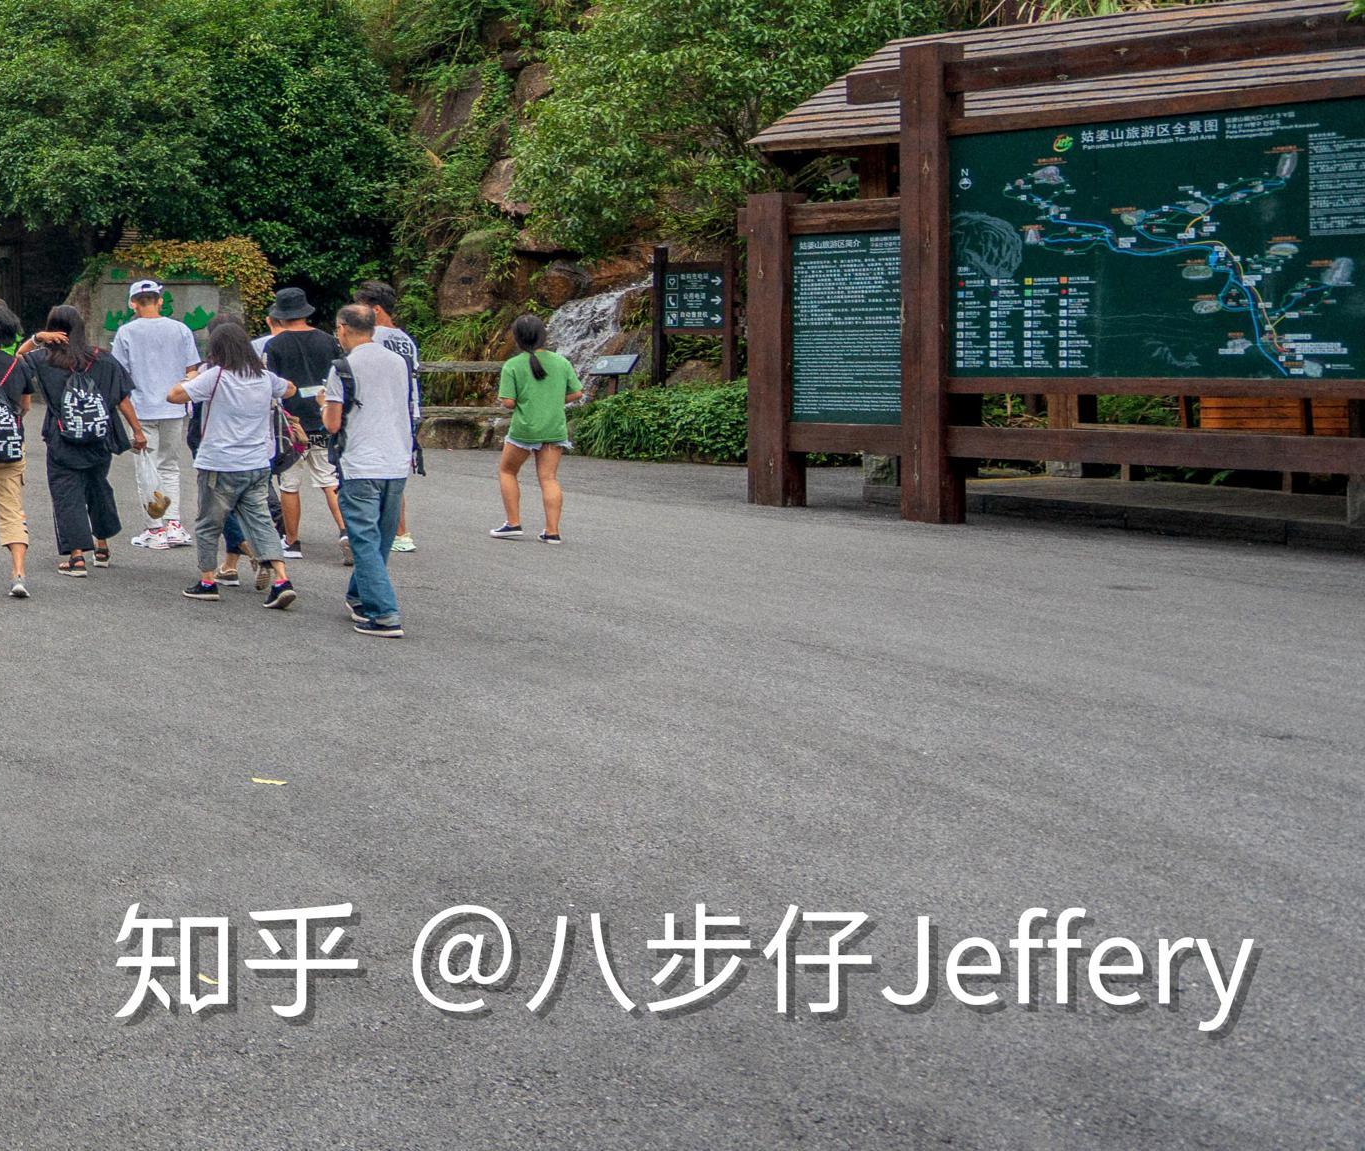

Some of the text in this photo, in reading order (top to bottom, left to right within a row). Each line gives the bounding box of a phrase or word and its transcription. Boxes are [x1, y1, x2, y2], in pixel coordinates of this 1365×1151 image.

[1081, 119, 1219, 143] 姑婆山旅游区全景图
